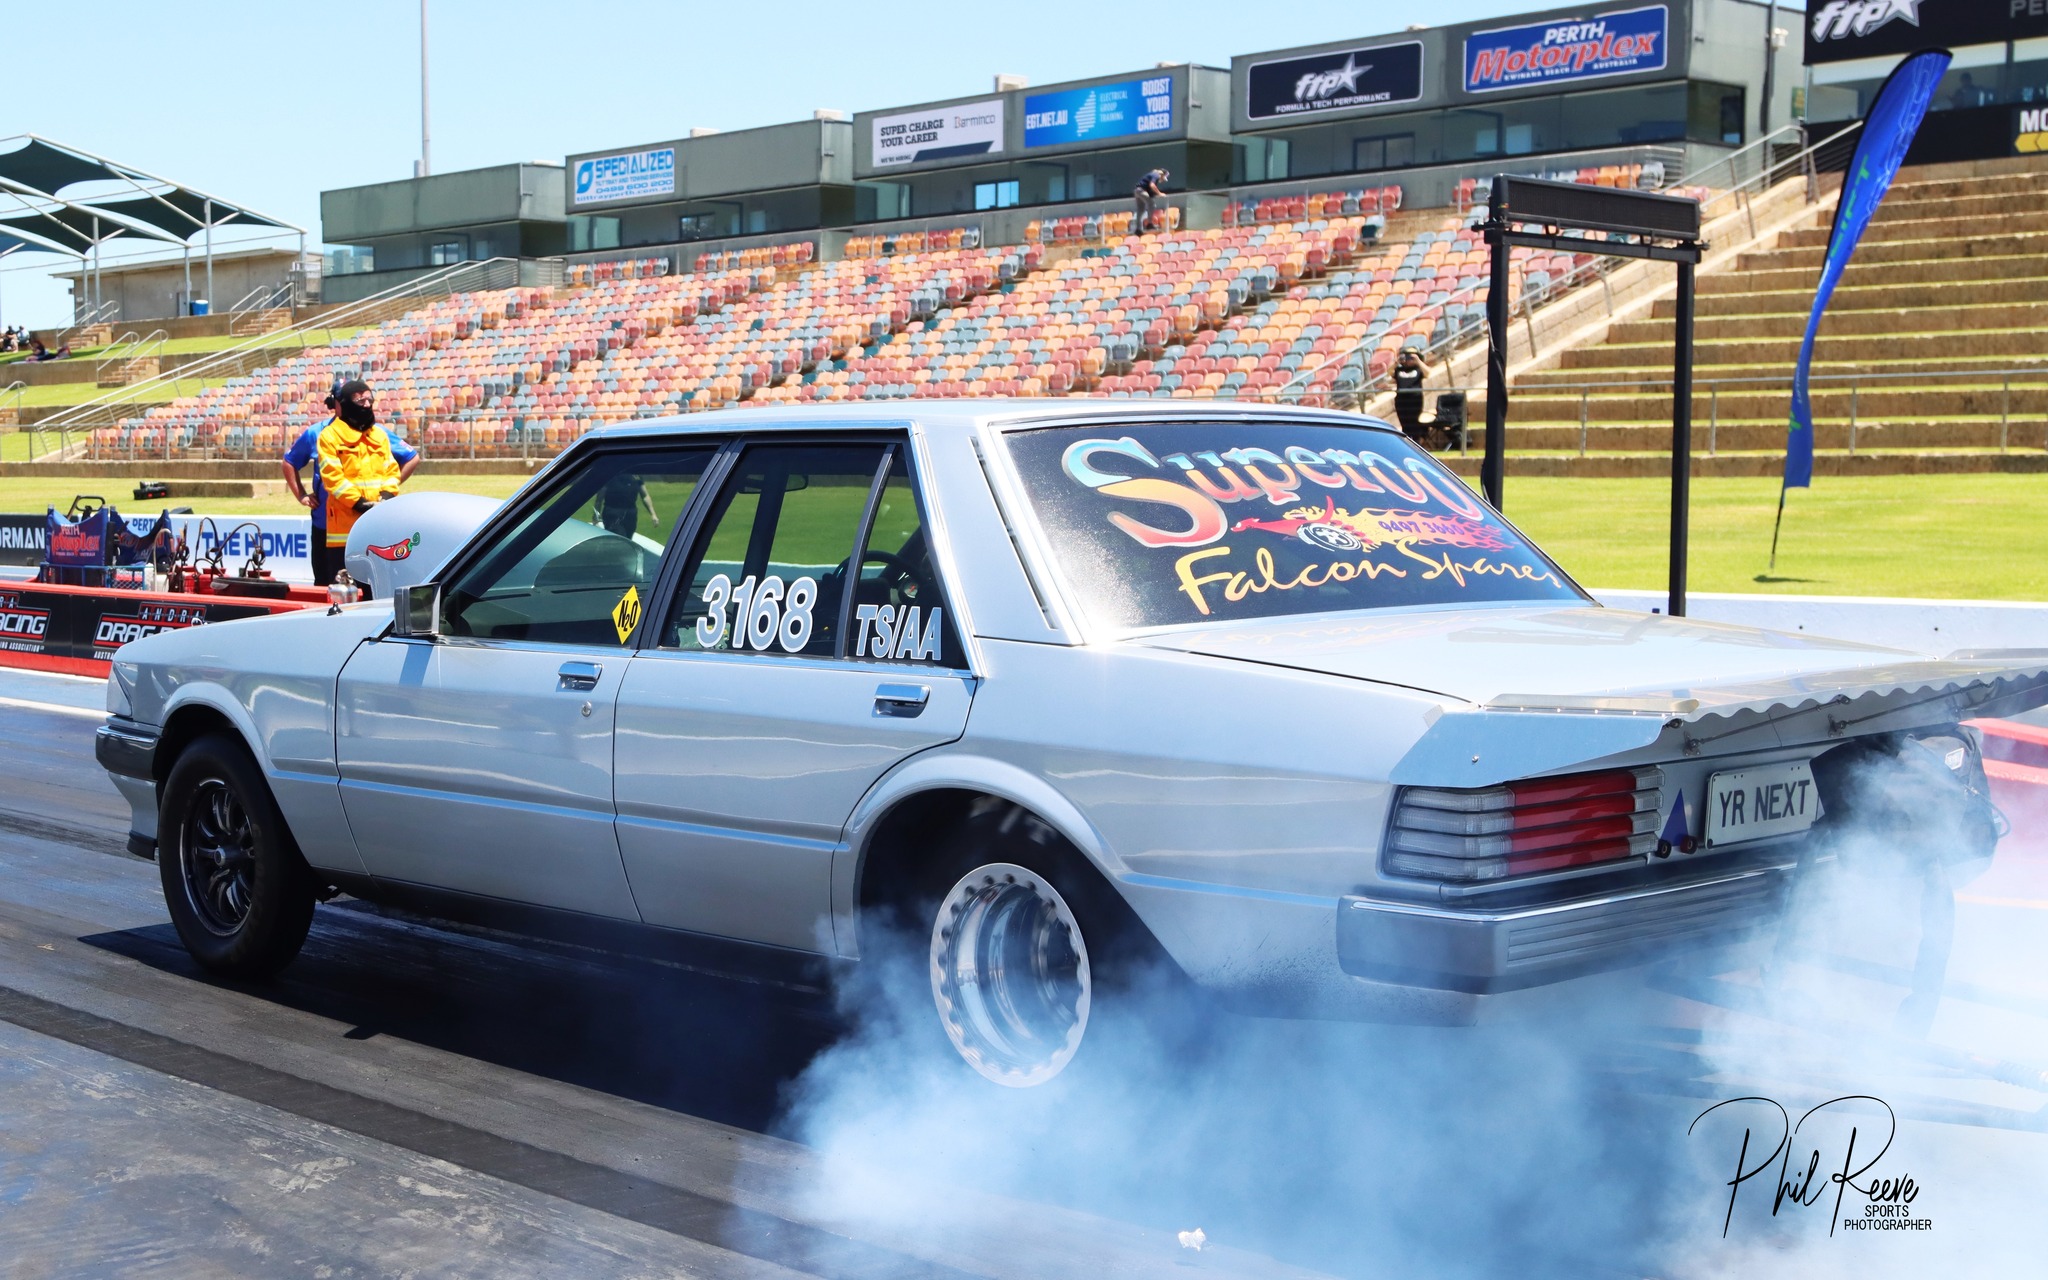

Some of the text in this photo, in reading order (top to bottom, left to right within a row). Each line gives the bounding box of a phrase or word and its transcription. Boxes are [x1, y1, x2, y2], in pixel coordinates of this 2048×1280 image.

[2010, 0, 2048, 18] PE
[1544, 21, 1606, 46] PERTH
[1469, 31, 1661, 86] Motorplex
[1593, 58, 1638, 70] AUSTRALIA
[1142, 78, 1170, 97] BOOST
[1146, 95, 1170, 113] YOUR
[1275, 92, 1391, 113] FORMULA TECH PERFORMANCE
[880, 119, 945, 137] SUPER CHARGE
[954, 114, 996, 129] Barminco
[1137, 112, 1170, 132] CAREER
[880, 131, 939, 148] YOUR CAREER
[595, 150, 674, 179] SPECIALIZED
[0, 526, 45, 549] RMAN
[202, 532, 240, 556] THE
[245, 532, 307, 558] HOME
[1176, 535, 1562, 616] Falcon Spares
[142, 607, 200, 623] ANDRA
[696, 574, 818, 652] 3168
[96, 622, 156, 643] DRAG
[856, 604, 943, 661] TS/AA
[9, 642, 40, 653] ASSOCIATION
[1719, 779, 1810, 828] YR NEXT
